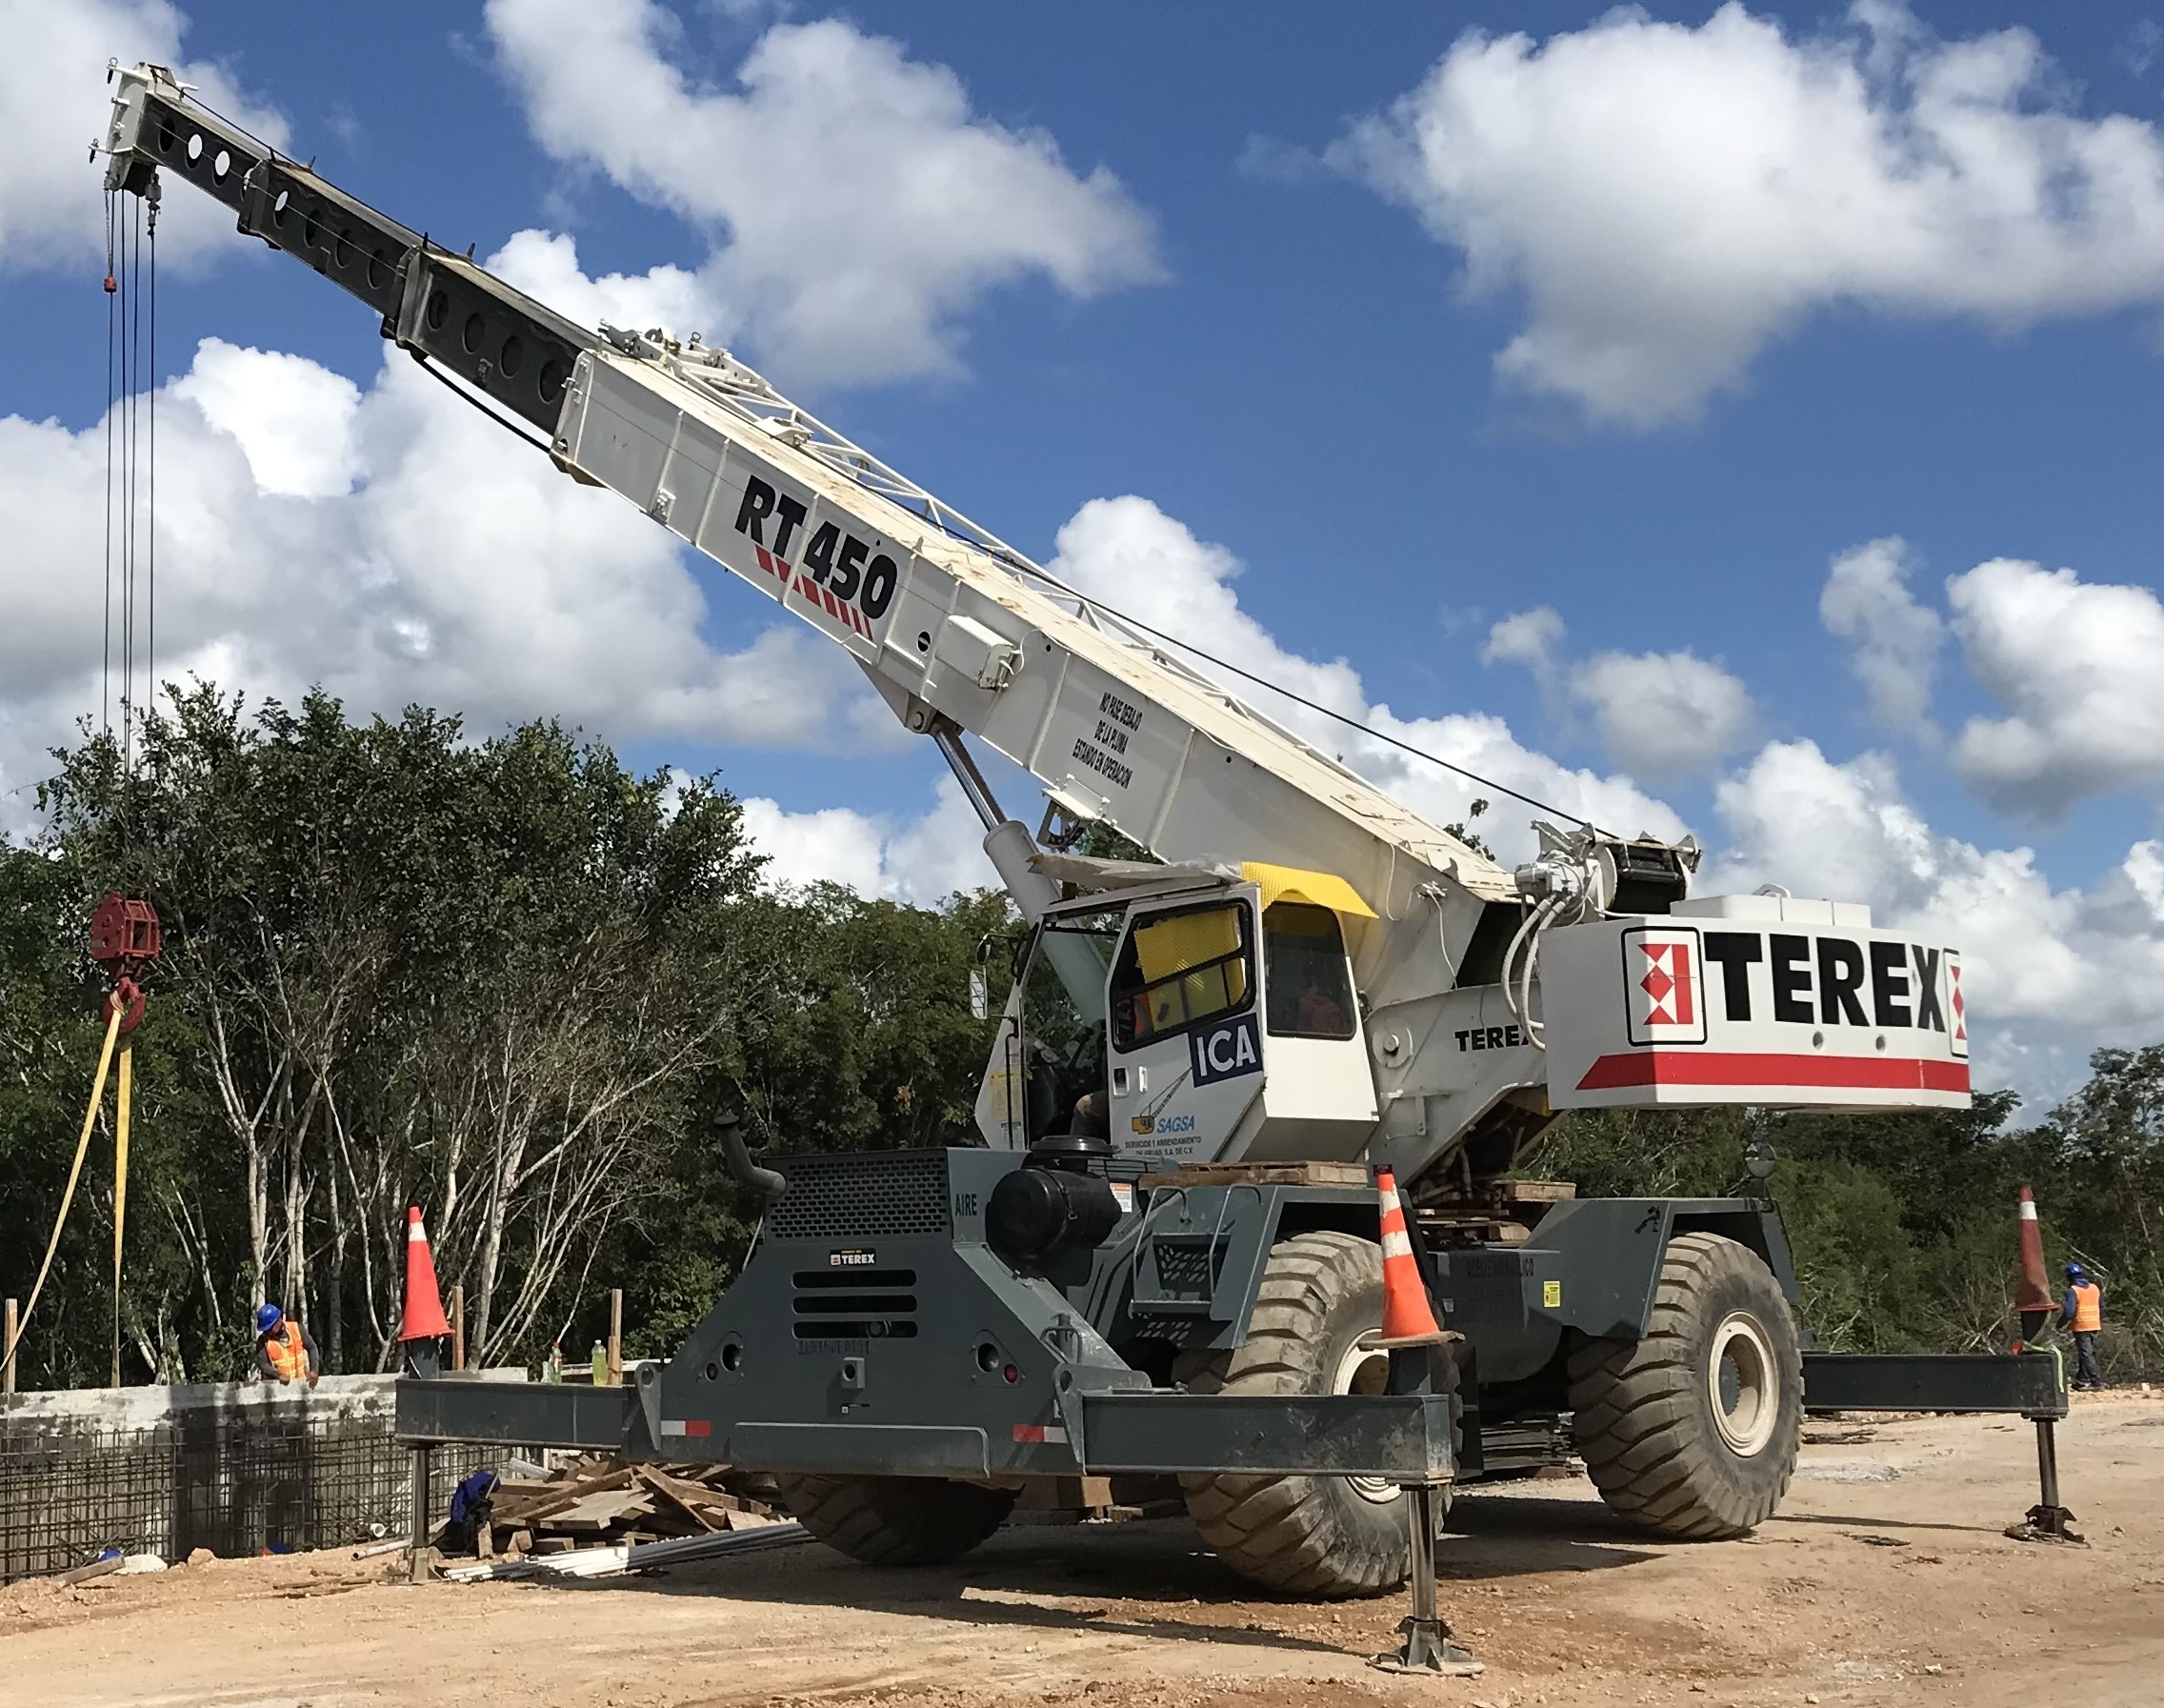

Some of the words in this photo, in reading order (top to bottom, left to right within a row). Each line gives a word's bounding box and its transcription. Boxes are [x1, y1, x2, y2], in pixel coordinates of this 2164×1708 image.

[1099, 692, 1111, 713] NO
[1107, 696, 1124, 720] PASE
[1119, 704, 1142, 732] DEBAJO
[1094, 720, 1106, 741] DE
[1108, 729, 1129, 755] PLUMA
[1072, 738, 1098, 768] ESTANDO
[1093, 751, 1106, 773] EN
[1101, 755, 1132, 789] OPERACION
[1703, 932, 1946, 1033] TEREX
[1196, 1025, 1256, 1077] ICA
[1157, 1115, 1194, 1134] SAGSA
[955, 1194, 977, 1216] AIRE
[841, 1254, 875, 1265] TEREX
